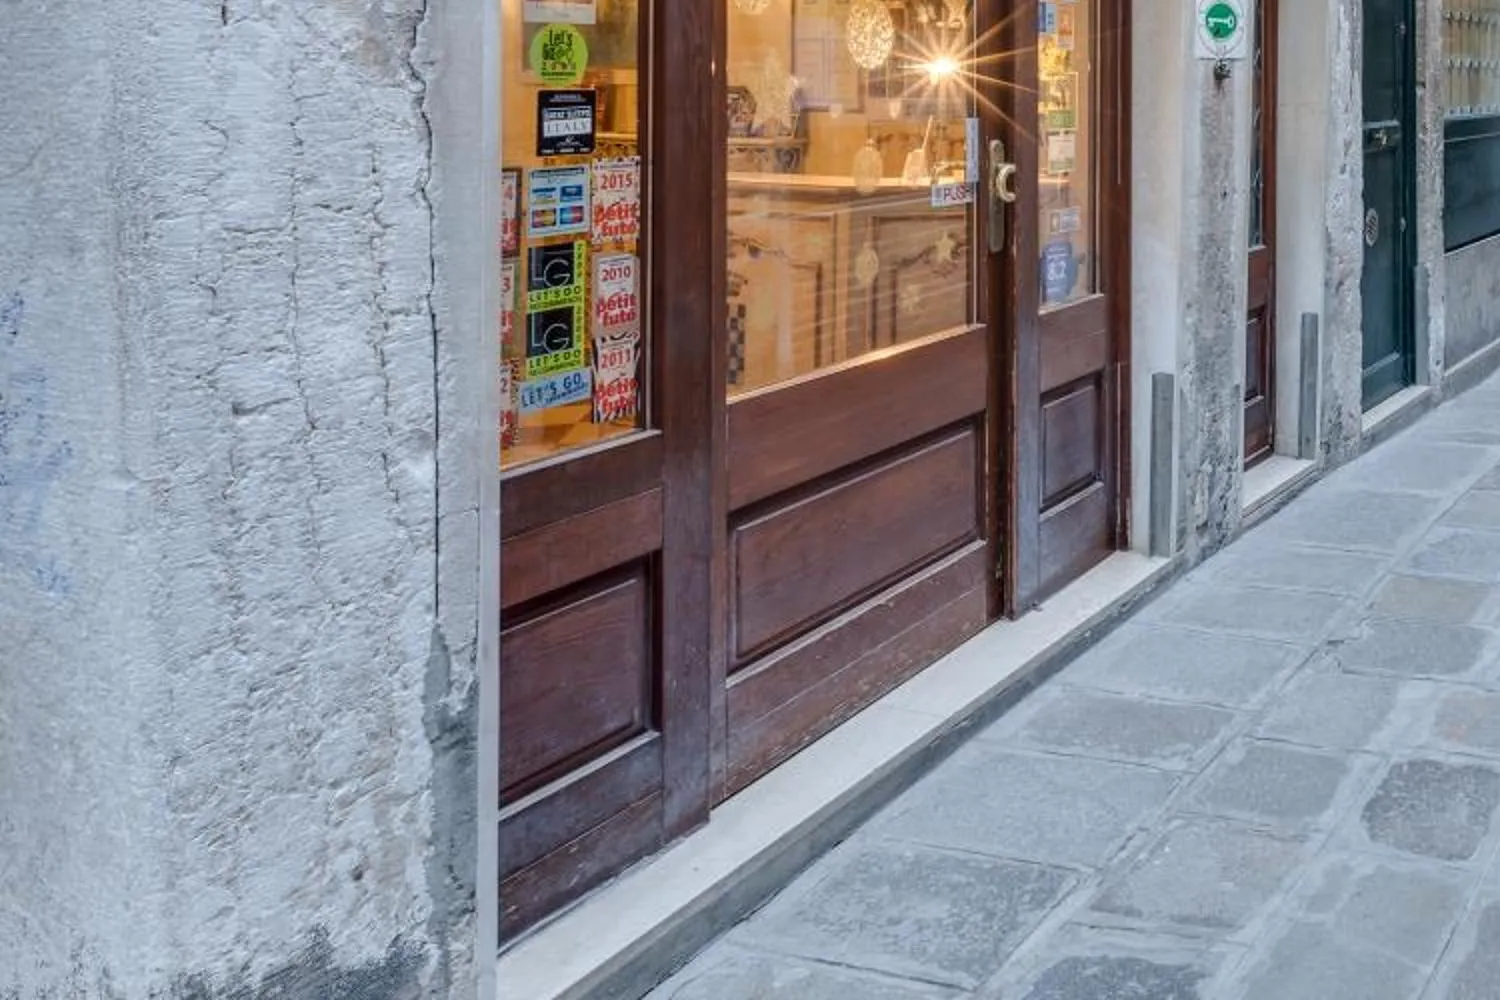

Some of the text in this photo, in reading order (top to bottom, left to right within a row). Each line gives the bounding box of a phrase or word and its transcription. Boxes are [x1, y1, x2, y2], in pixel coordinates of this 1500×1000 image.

[546, 120, 588, 134] ITALY
[600, 172, 633, 191] 2015
[602, 265, 632, 282] 2010
[521, 381, 557, 408] LET'S
[563, 371, 582, 390] GO
